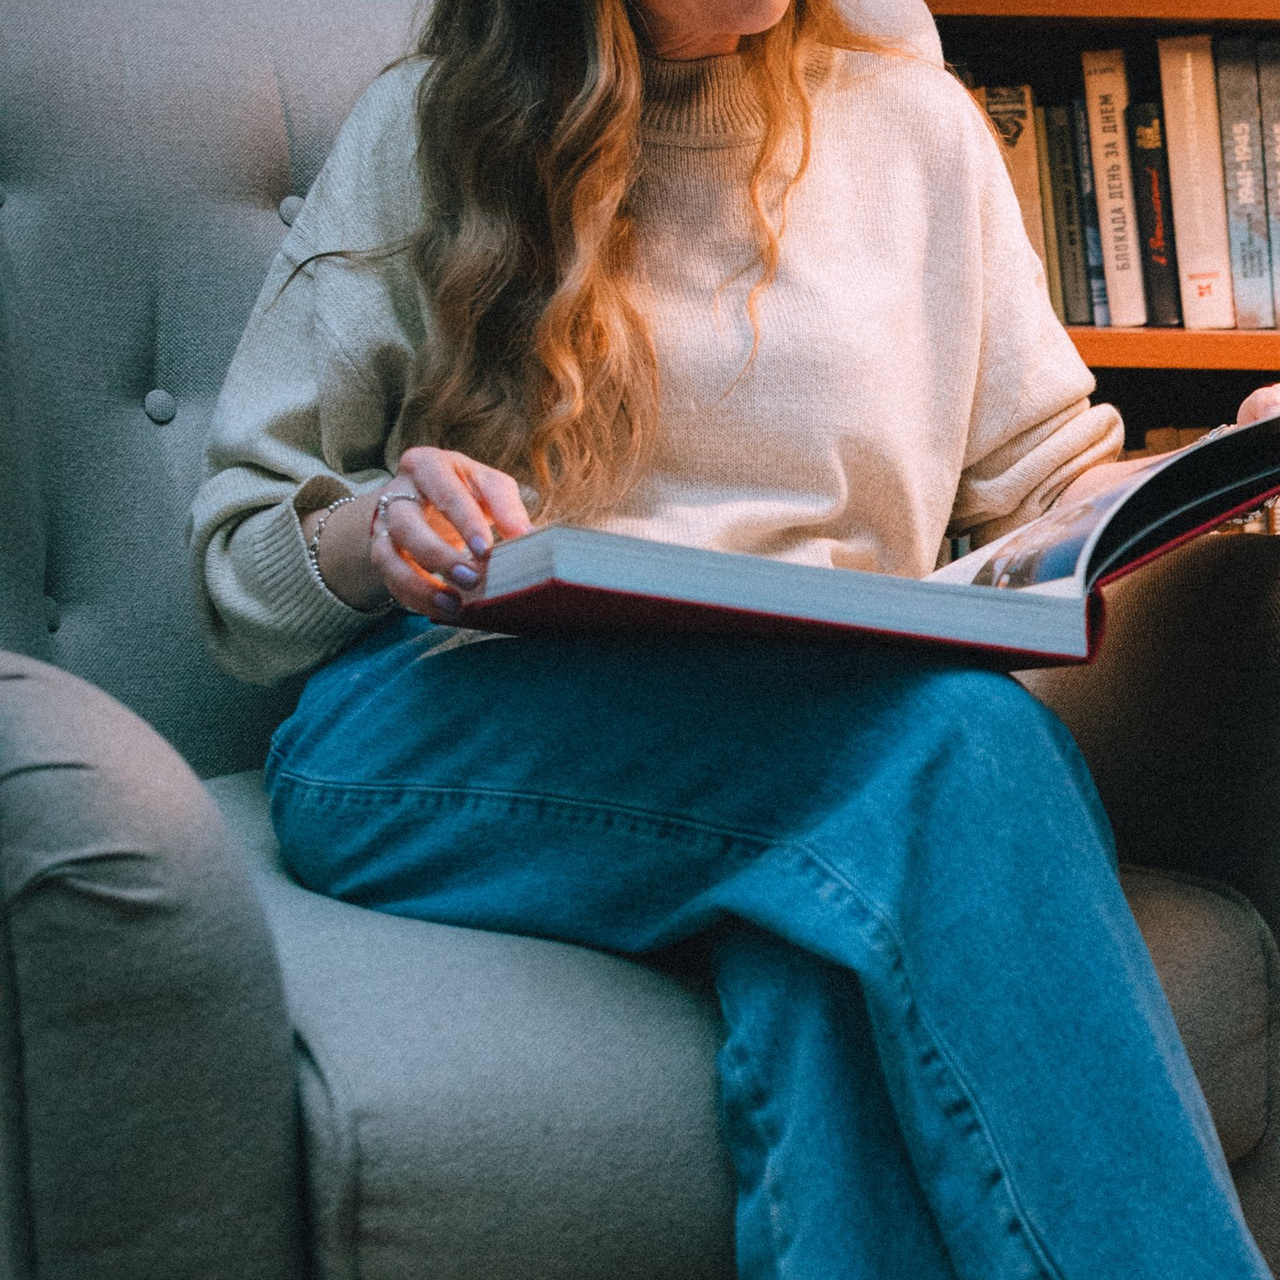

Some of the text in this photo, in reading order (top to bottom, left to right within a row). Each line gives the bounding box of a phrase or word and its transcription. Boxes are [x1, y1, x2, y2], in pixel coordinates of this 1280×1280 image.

[1100, 94, 1132, 271] БЛОКАДА ДЕНЬ ЗА ДНЕМ
